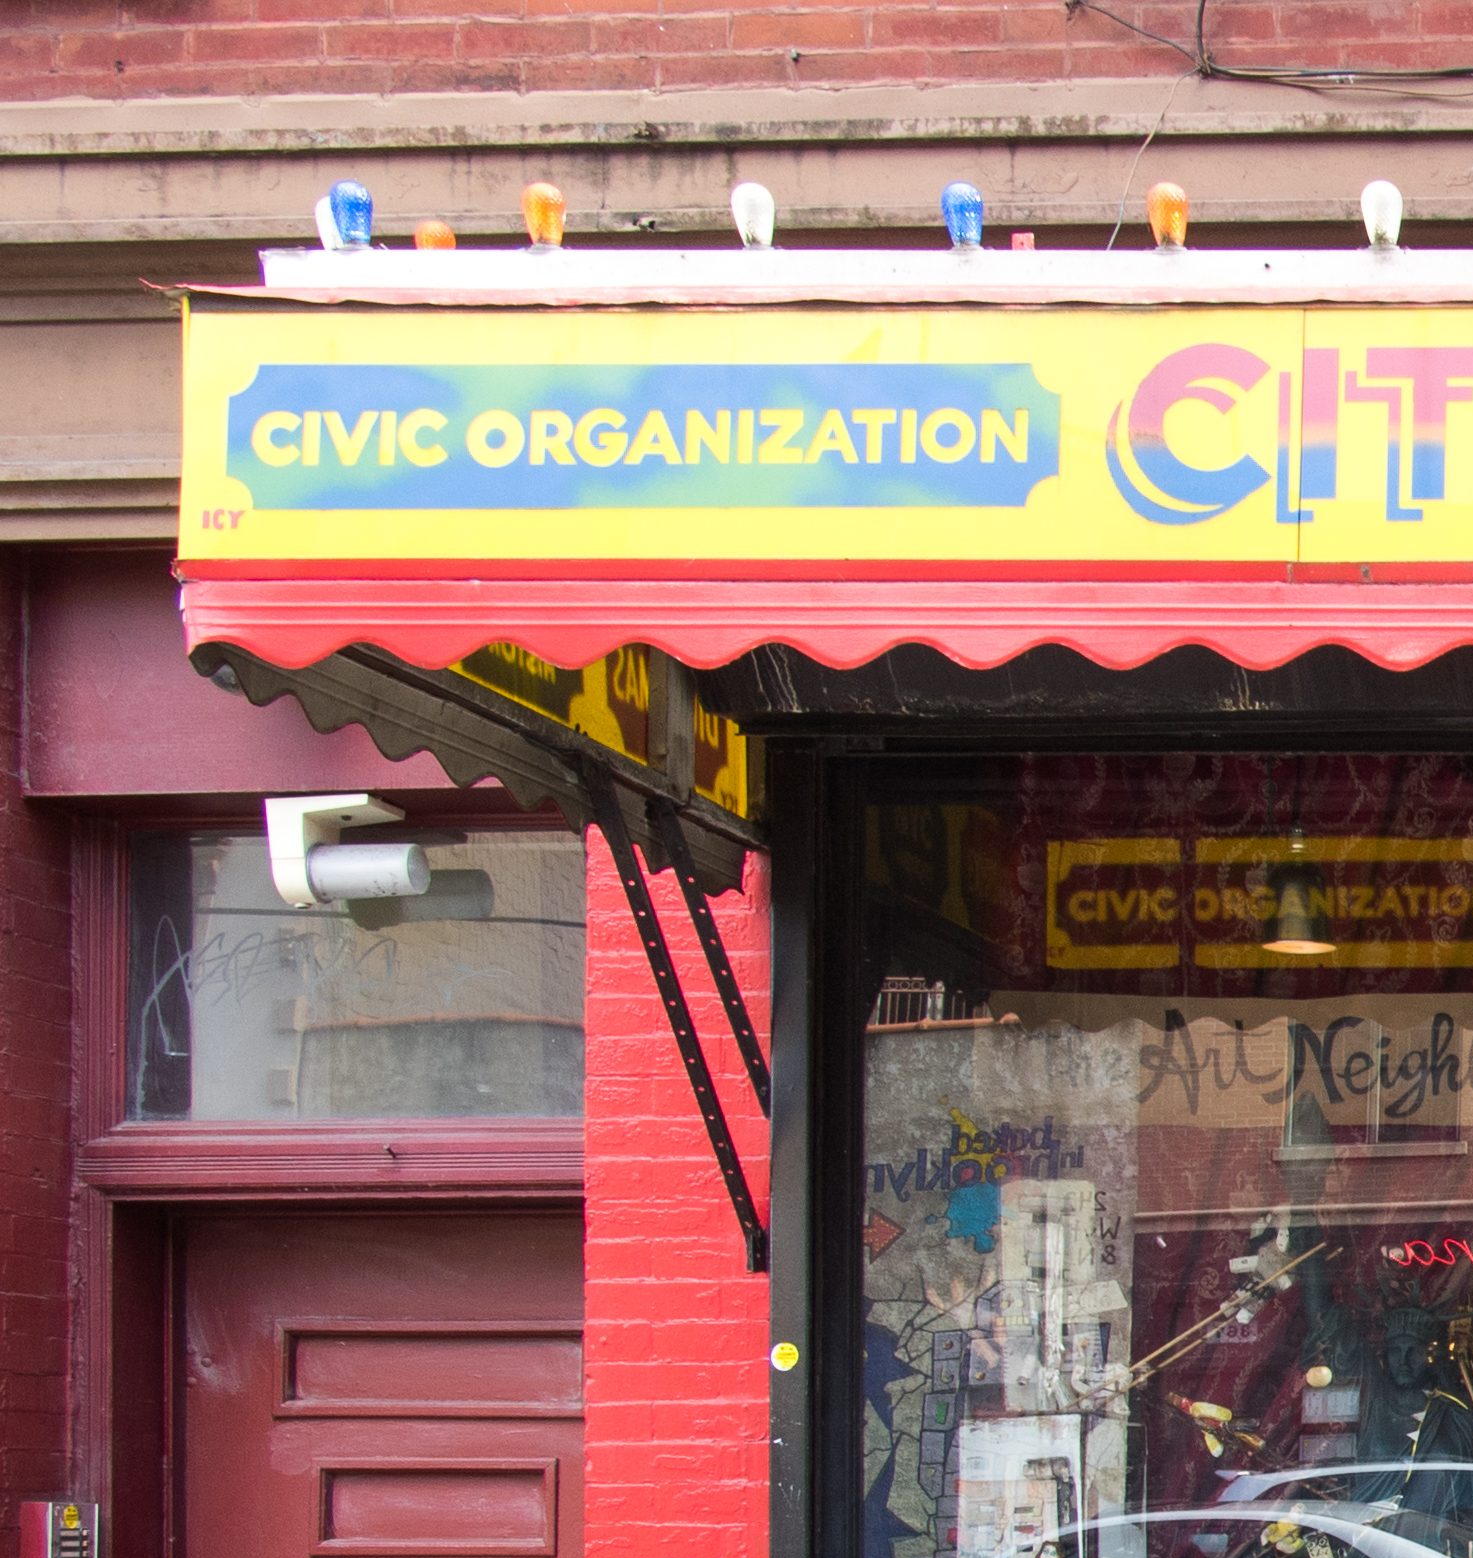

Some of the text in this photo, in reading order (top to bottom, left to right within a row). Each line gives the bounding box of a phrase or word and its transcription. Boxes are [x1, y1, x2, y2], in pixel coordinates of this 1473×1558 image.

[250, 407, 1030, 469] CIVIC ORGANIZATION
[201, 510, 246, 531] ICY
[1140, 1008, 1281, 1115] Art
